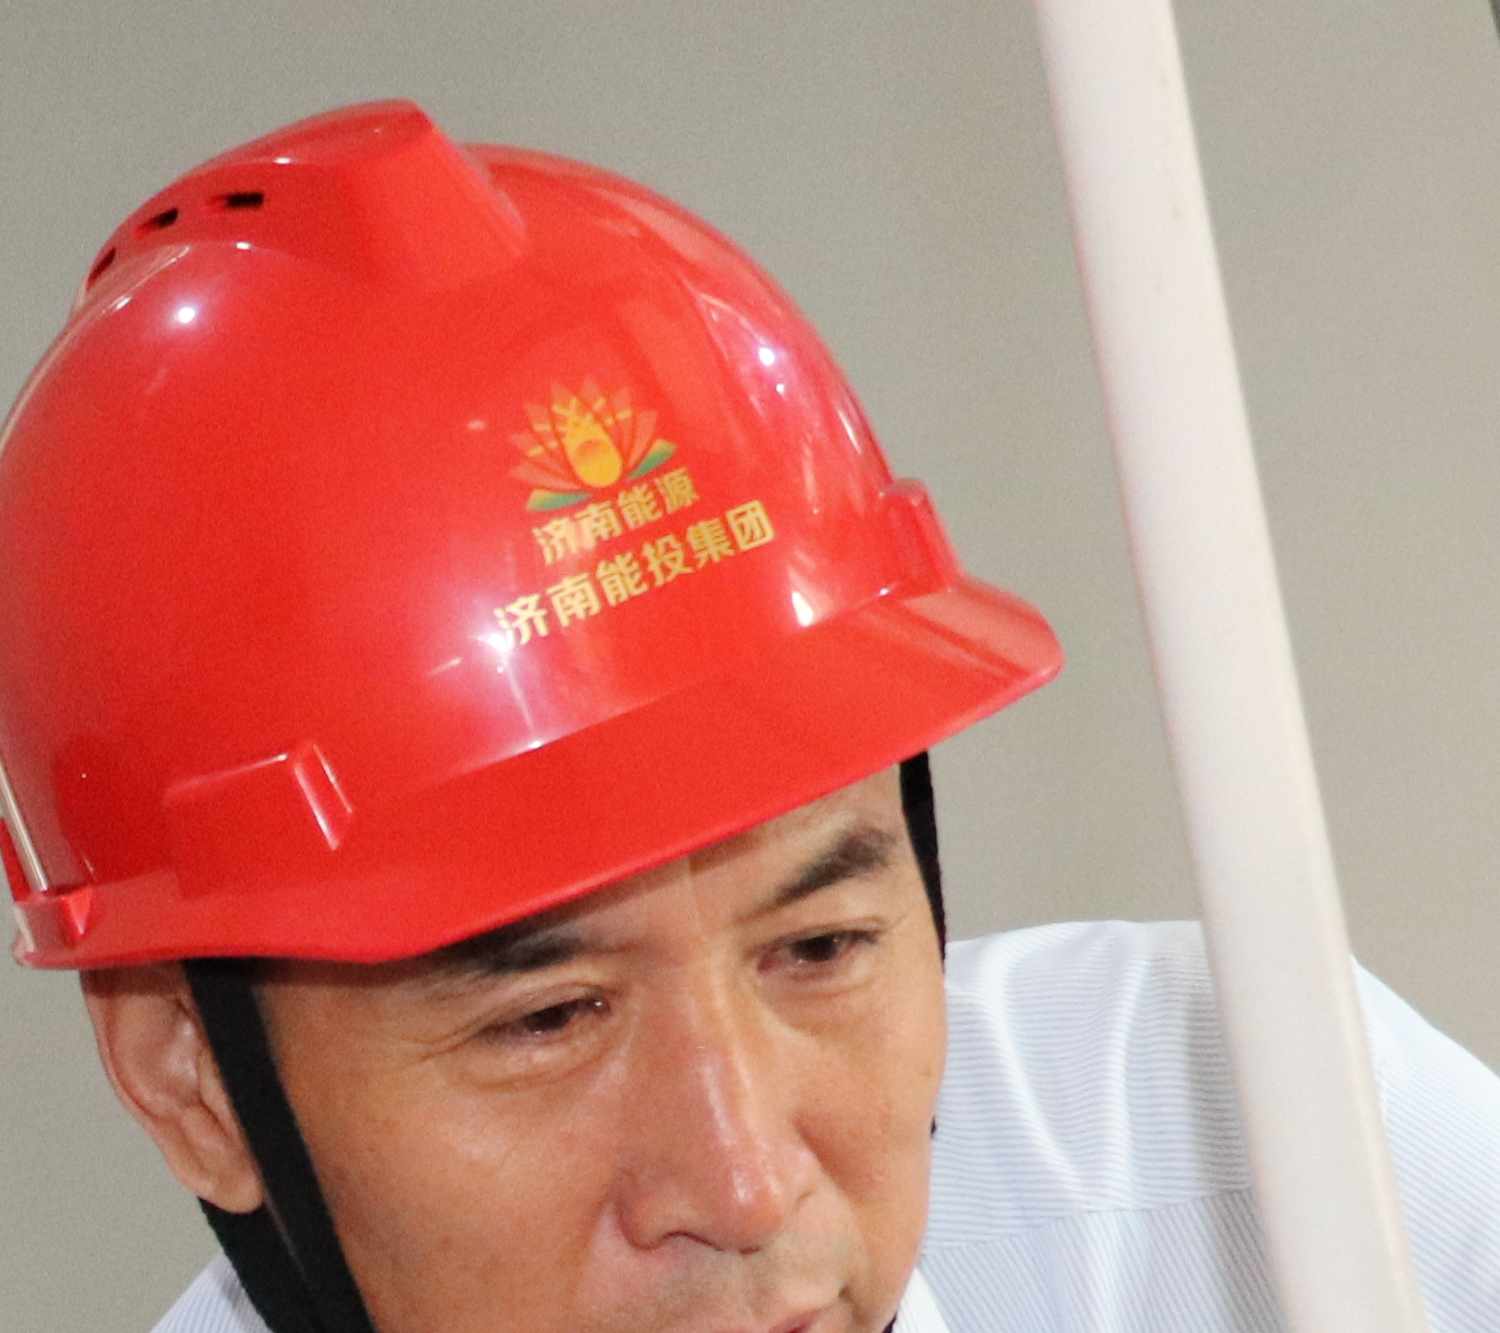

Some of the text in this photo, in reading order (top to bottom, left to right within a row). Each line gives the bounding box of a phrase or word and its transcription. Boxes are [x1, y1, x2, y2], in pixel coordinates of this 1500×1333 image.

[493, 499, 776, 652] 济南能投集团
[531, 467, 700, 566] 济南能源
